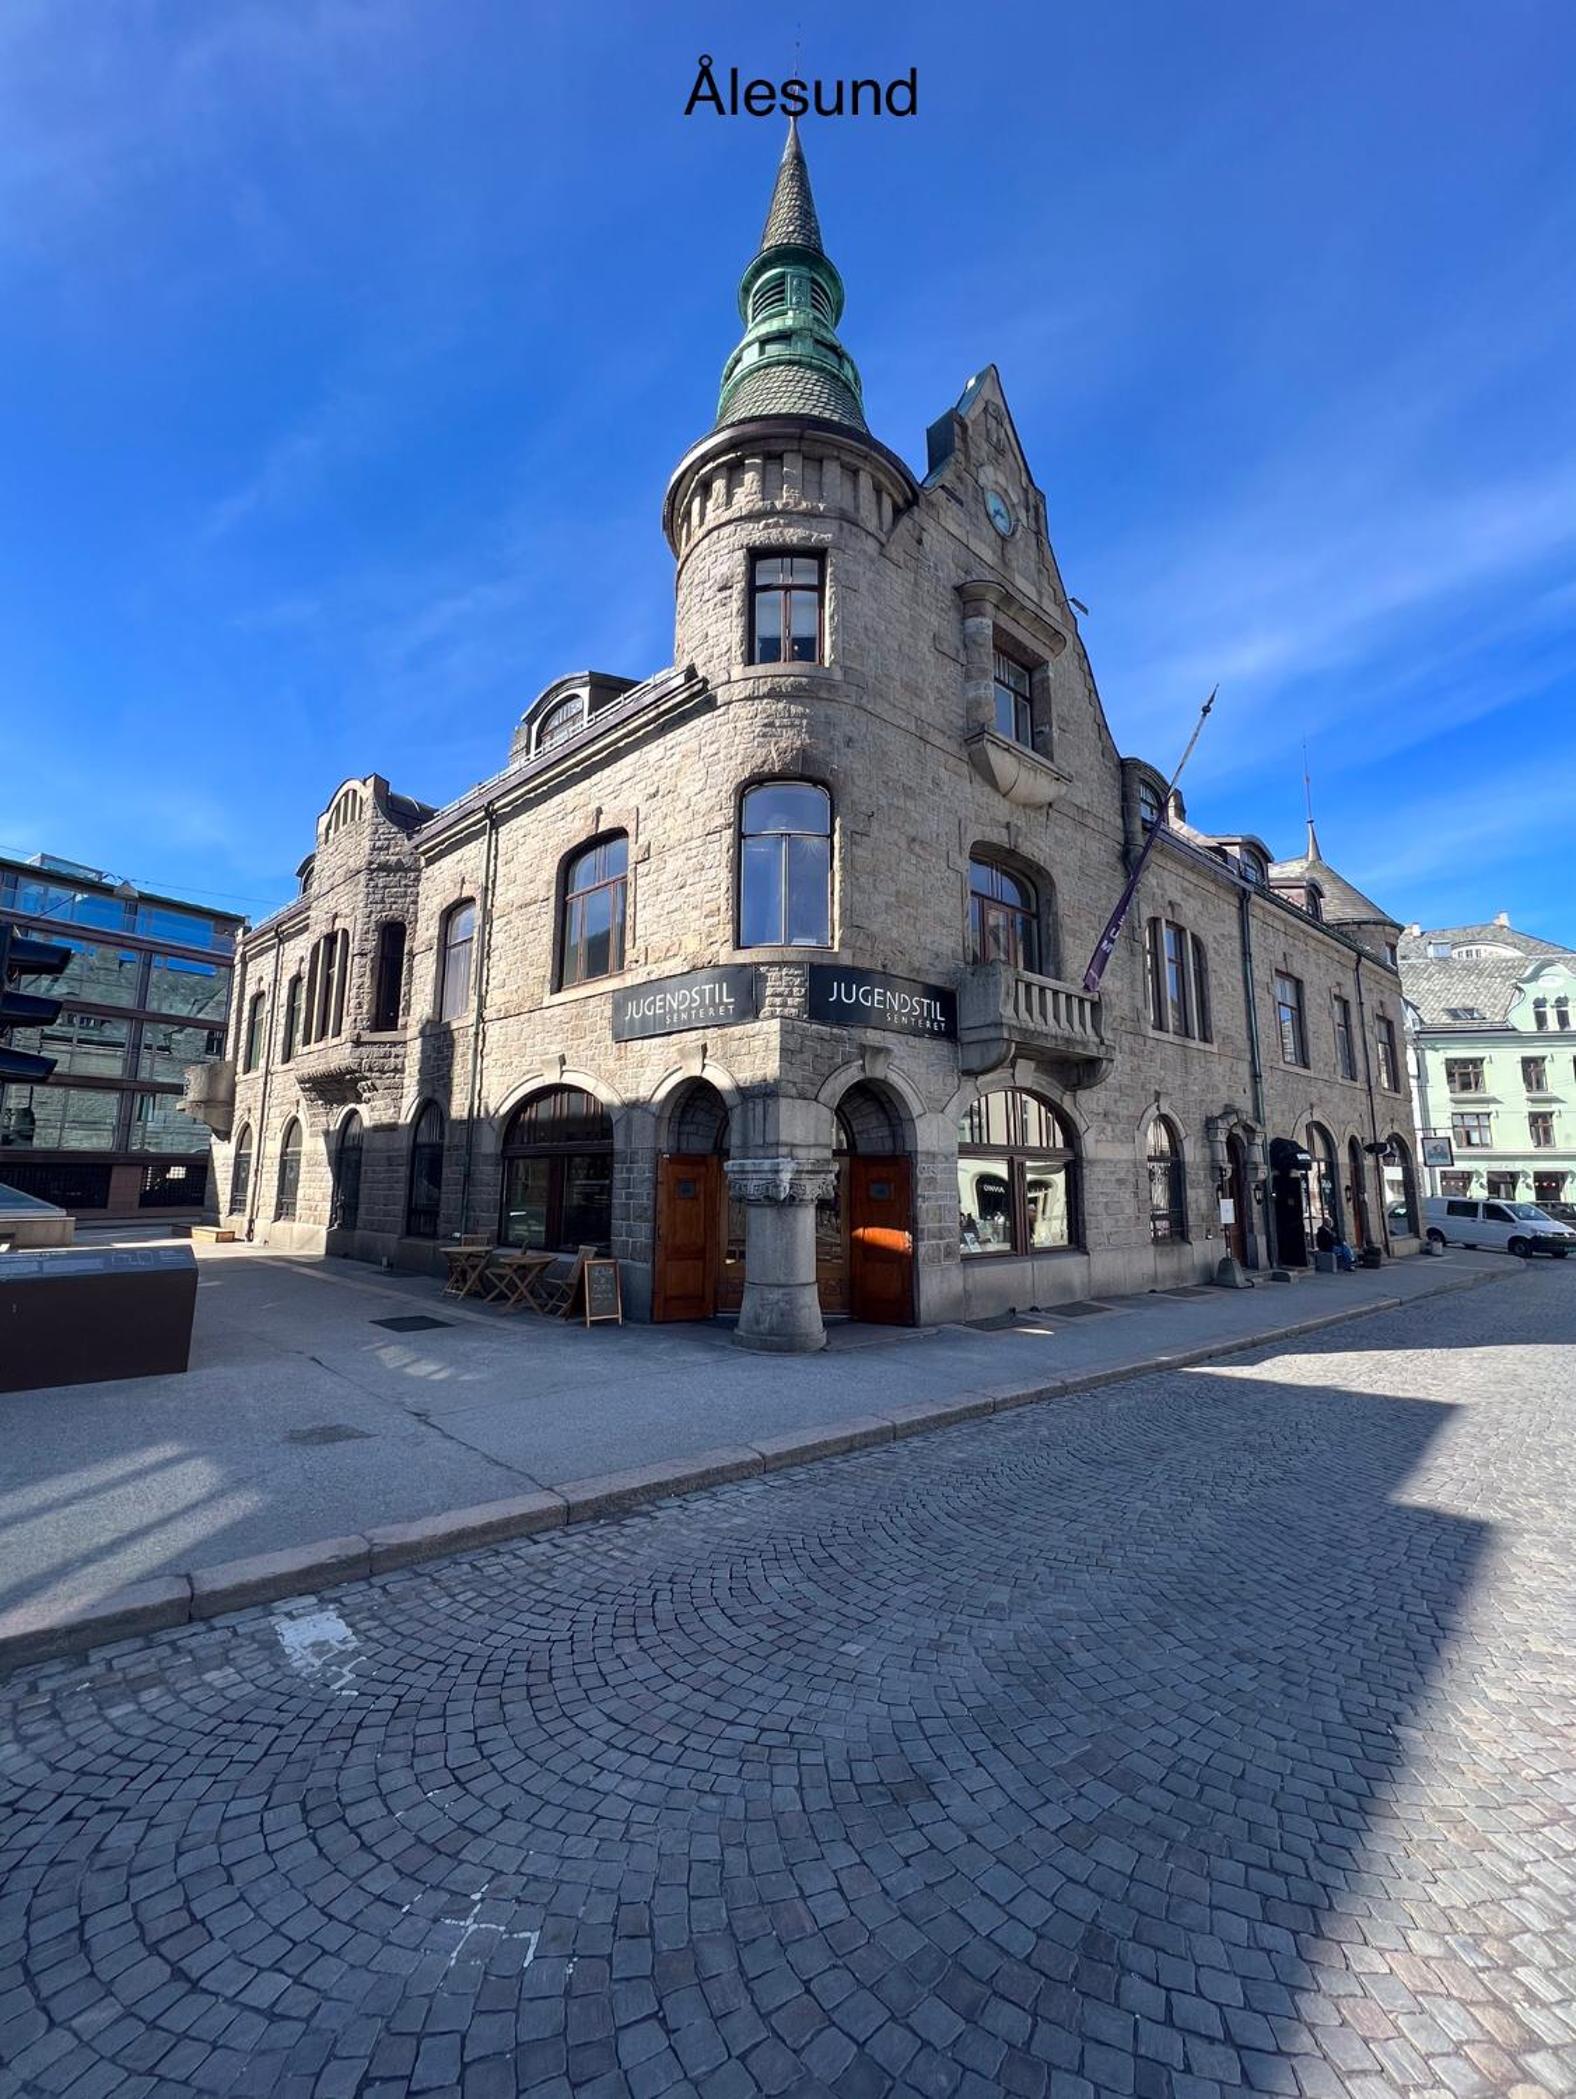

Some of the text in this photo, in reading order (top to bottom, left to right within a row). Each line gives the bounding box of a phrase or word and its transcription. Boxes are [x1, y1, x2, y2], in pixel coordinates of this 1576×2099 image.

[625, 982, 735, 1020] JUGENDSTIL
[666, 1005, 735, 1024] SENTERET
[829, 981, 945, 1021] JUGENDSTIL
[886, 1012, 946, 1031] SENTERET
